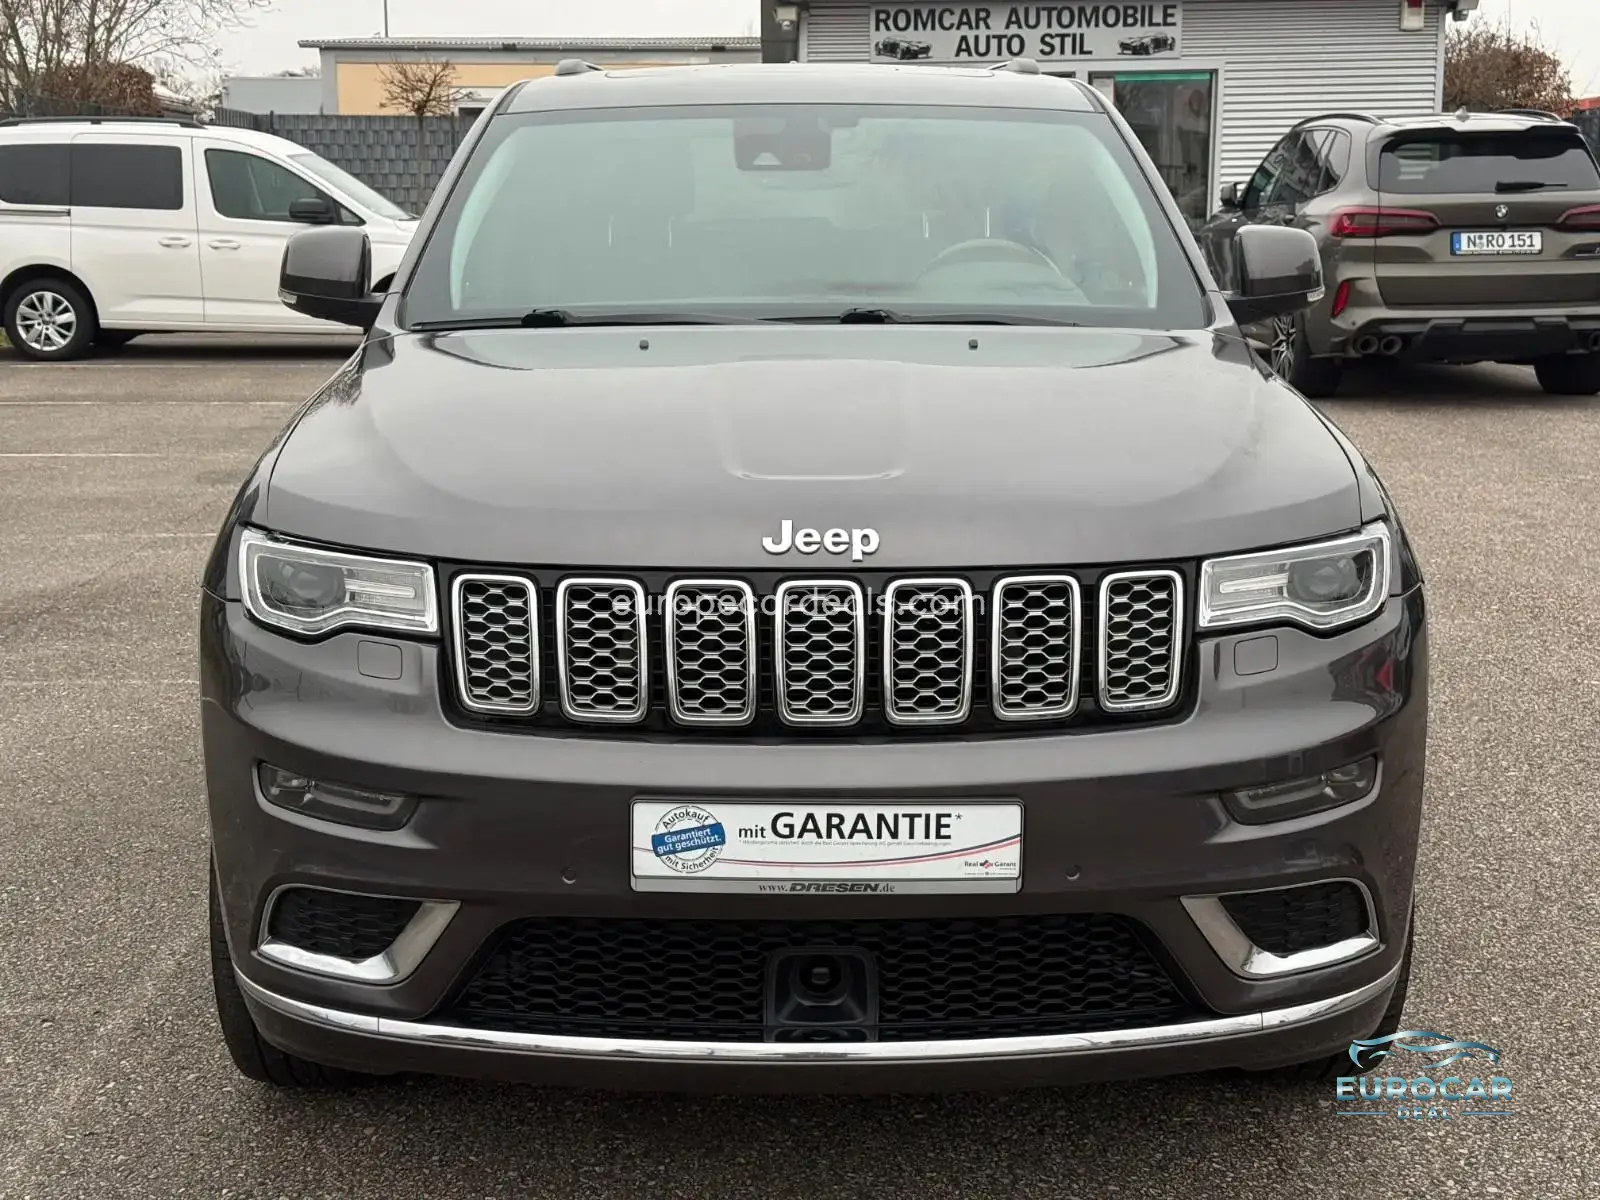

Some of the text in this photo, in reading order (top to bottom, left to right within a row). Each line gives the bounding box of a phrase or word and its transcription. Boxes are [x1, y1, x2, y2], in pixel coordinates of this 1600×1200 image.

[874, 4, 1177, 32] ROMCAR AUTOMOBILE
[954, 32, 1093, 57] AUTO STIL
[1467, 233, 1536, 248] N RO 151
[762, 519, 880, 562] Jeep
[662, 808, 710, 829] Autokauf
[664, 828, 712, 843] Garantiert
[738, 823, 766, 839] mit
[657, 834, 722, 854] gut geschützt.
[665, 847, 719, 870] mit Sicherheit
